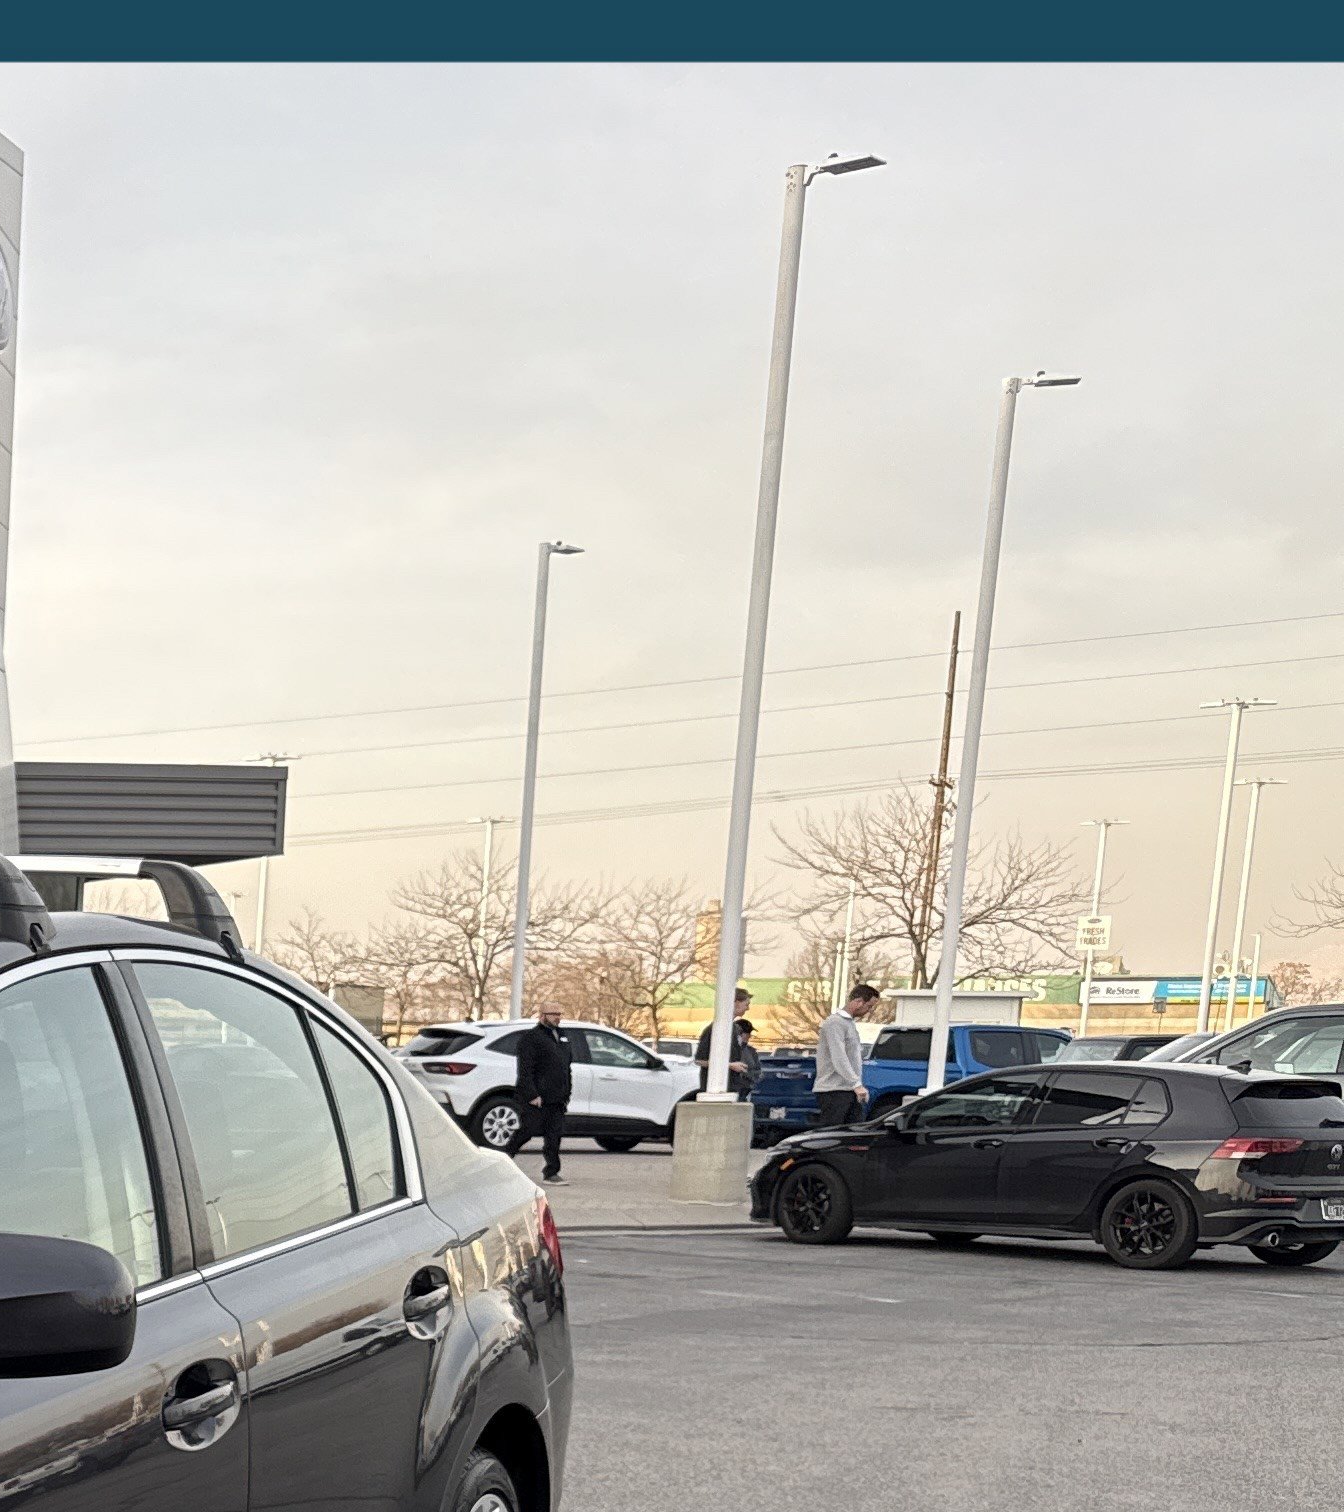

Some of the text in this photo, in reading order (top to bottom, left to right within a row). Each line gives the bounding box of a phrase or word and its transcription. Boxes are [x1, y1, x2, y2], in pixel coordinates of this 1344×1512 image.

[1081, 927, 1105, 935] FRESH
[1079, 936, 1107, 946] TRADES
[1105, 986, 1140, 995] ReStore
